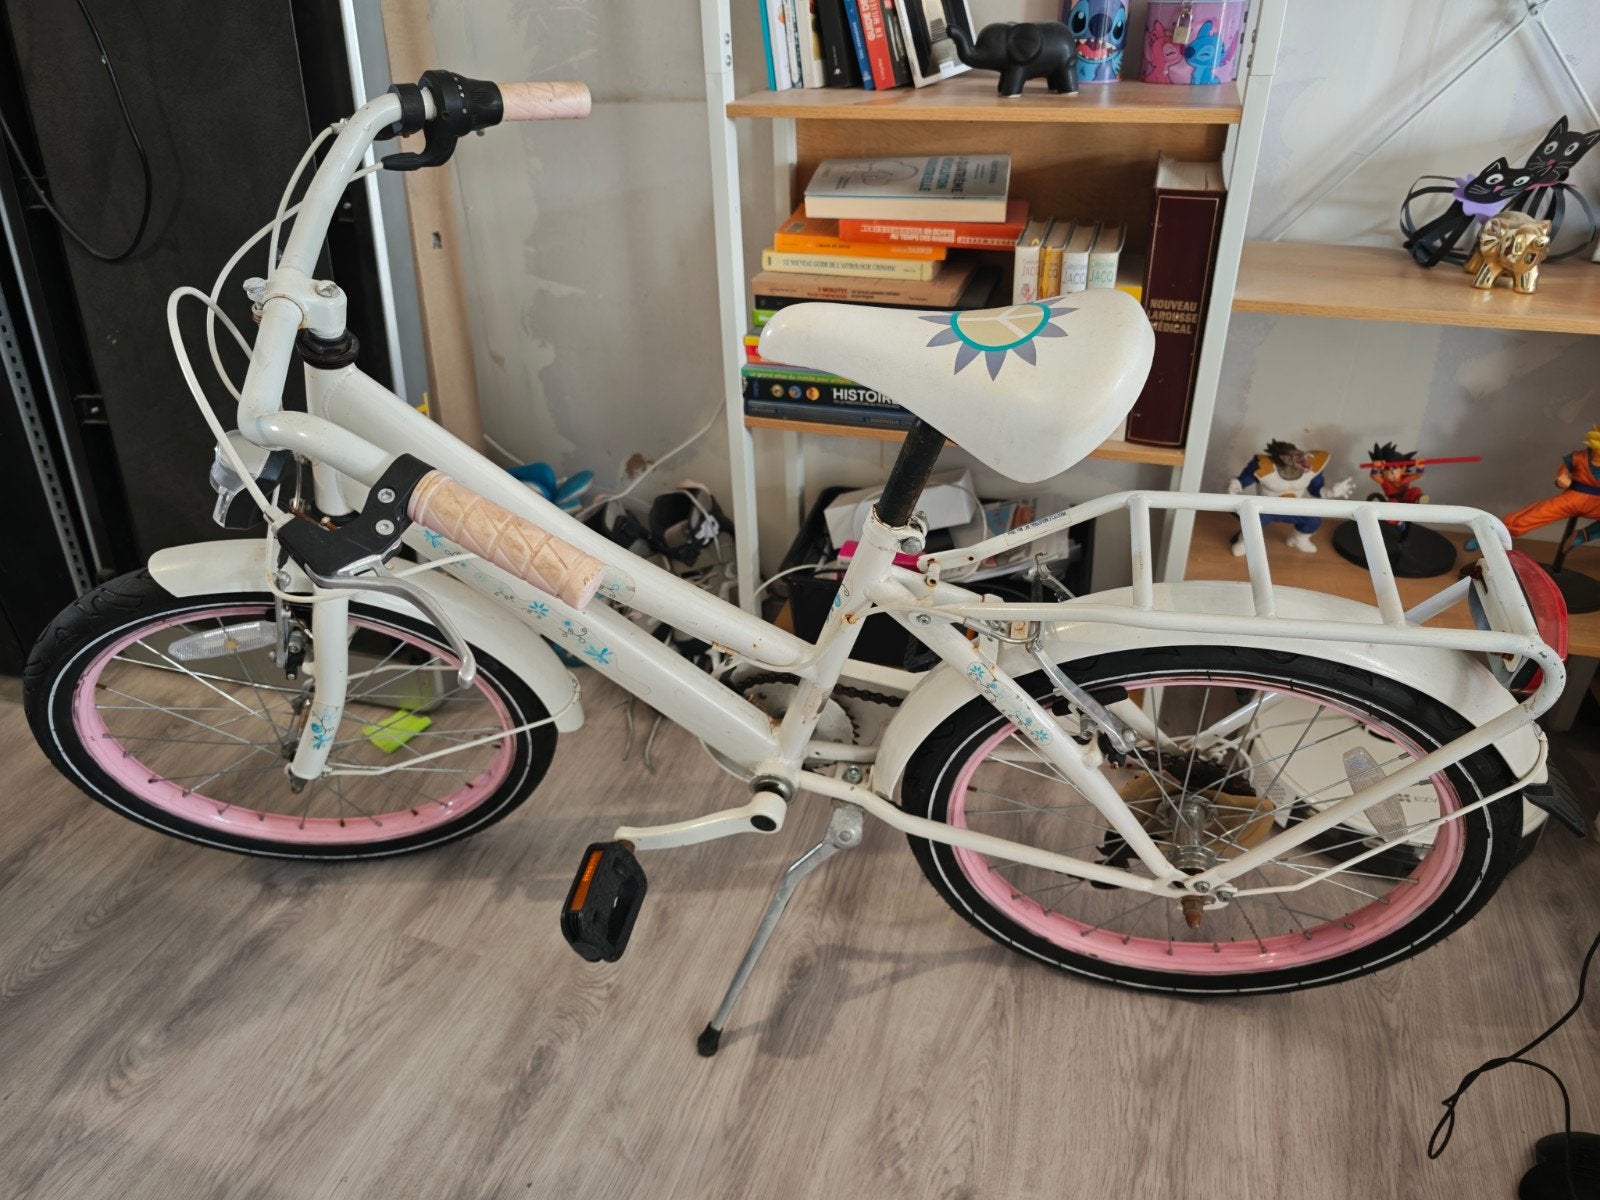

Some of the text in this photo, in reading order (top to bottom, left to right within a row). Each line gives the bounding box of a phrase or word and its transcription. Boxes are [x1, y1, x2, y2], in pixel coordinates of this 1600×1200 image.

[1062, 271, 1086, 285] JACQ
[1089, 270, 1114, 283] JACQ
[1150, 298, 1197, 312] NOUVEAU
[1147, 310, 1198, 323] LAROUSSE
[832, 387, 893, 404] HISTOIR
